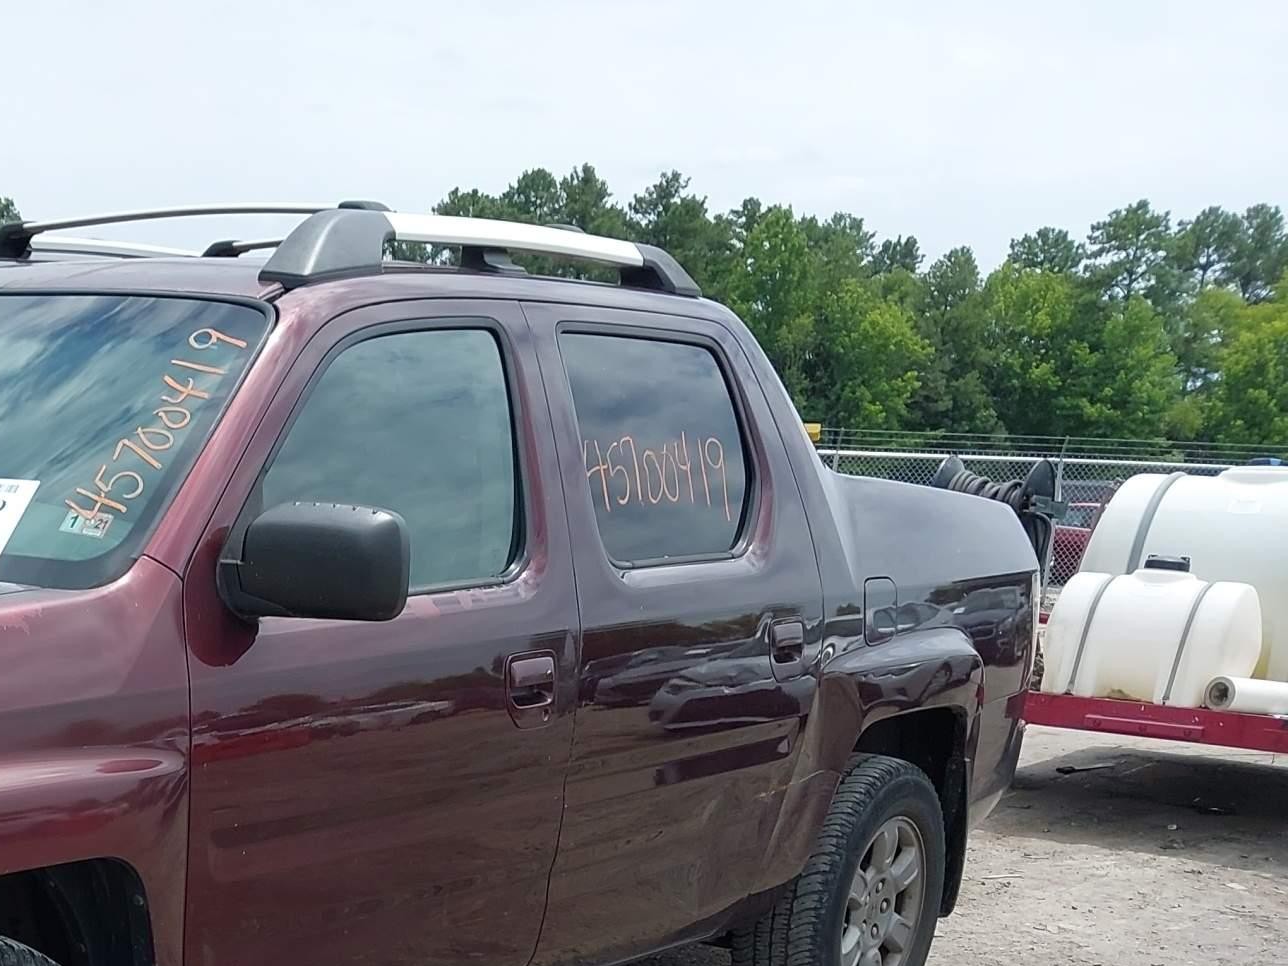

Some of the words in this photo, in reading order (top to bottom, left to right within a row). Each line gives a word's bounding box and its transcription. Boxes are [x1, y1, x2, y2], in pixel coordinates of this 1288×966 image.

[64, 327, 248, 520] 45700419
[583, 431, 731, 521] 45700419
[93, 518, 110, 530] 21
